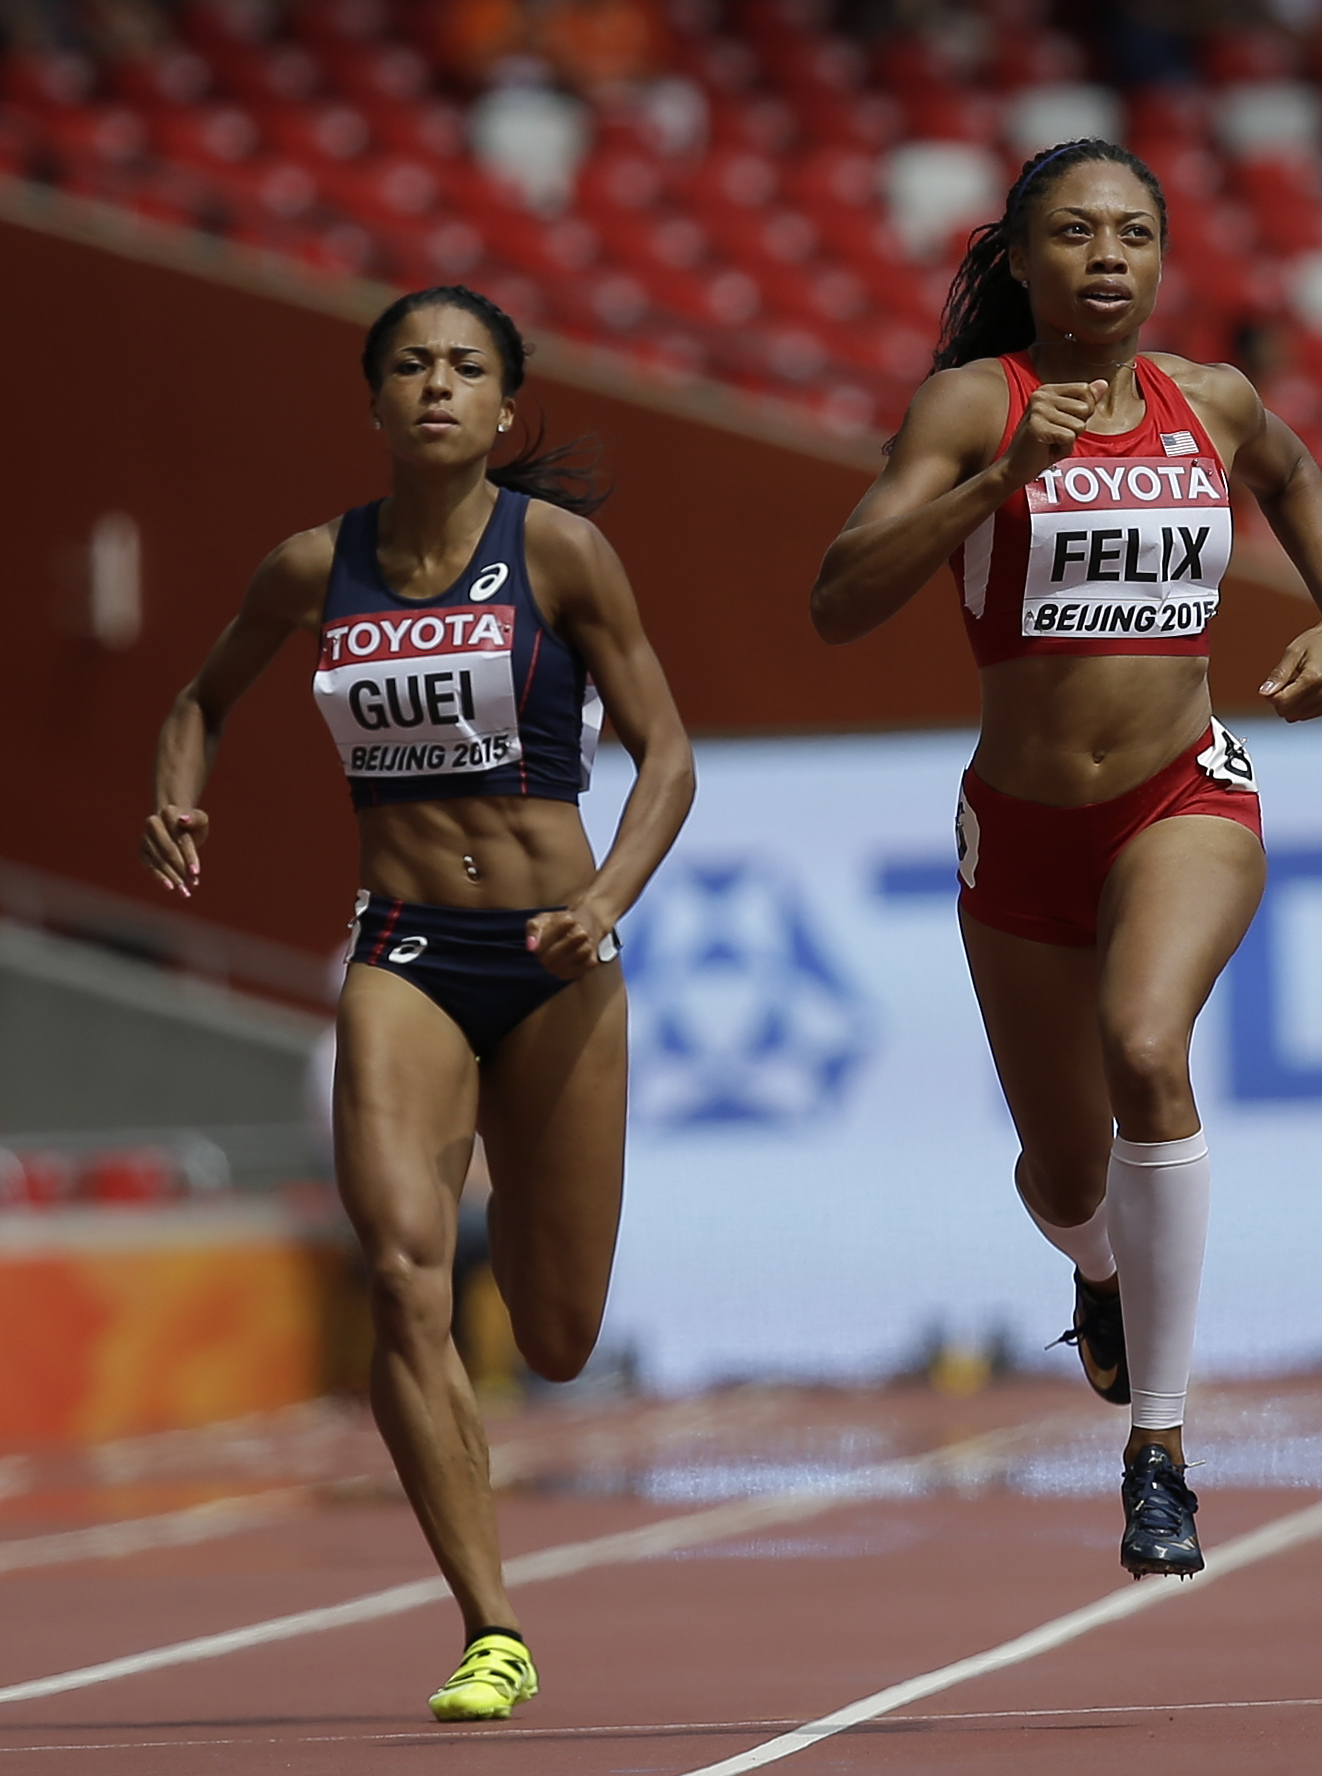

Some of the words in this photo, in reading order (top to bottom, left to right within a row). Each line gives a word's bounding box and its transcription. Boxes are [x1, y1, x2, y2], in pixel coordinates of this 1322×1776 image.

[1038, 466, 1220, 504] TOYOTA
[1051, 526, 1211, 583] FELIX
[326, 613, 504, 661] TOYOTA
[1034, 603, 1156, 632] BEIJING
[349, 670, 475, 731] GUEI
[351, 745, 445, 771] BEIJING
[452, 735, 509, 768] 2015
